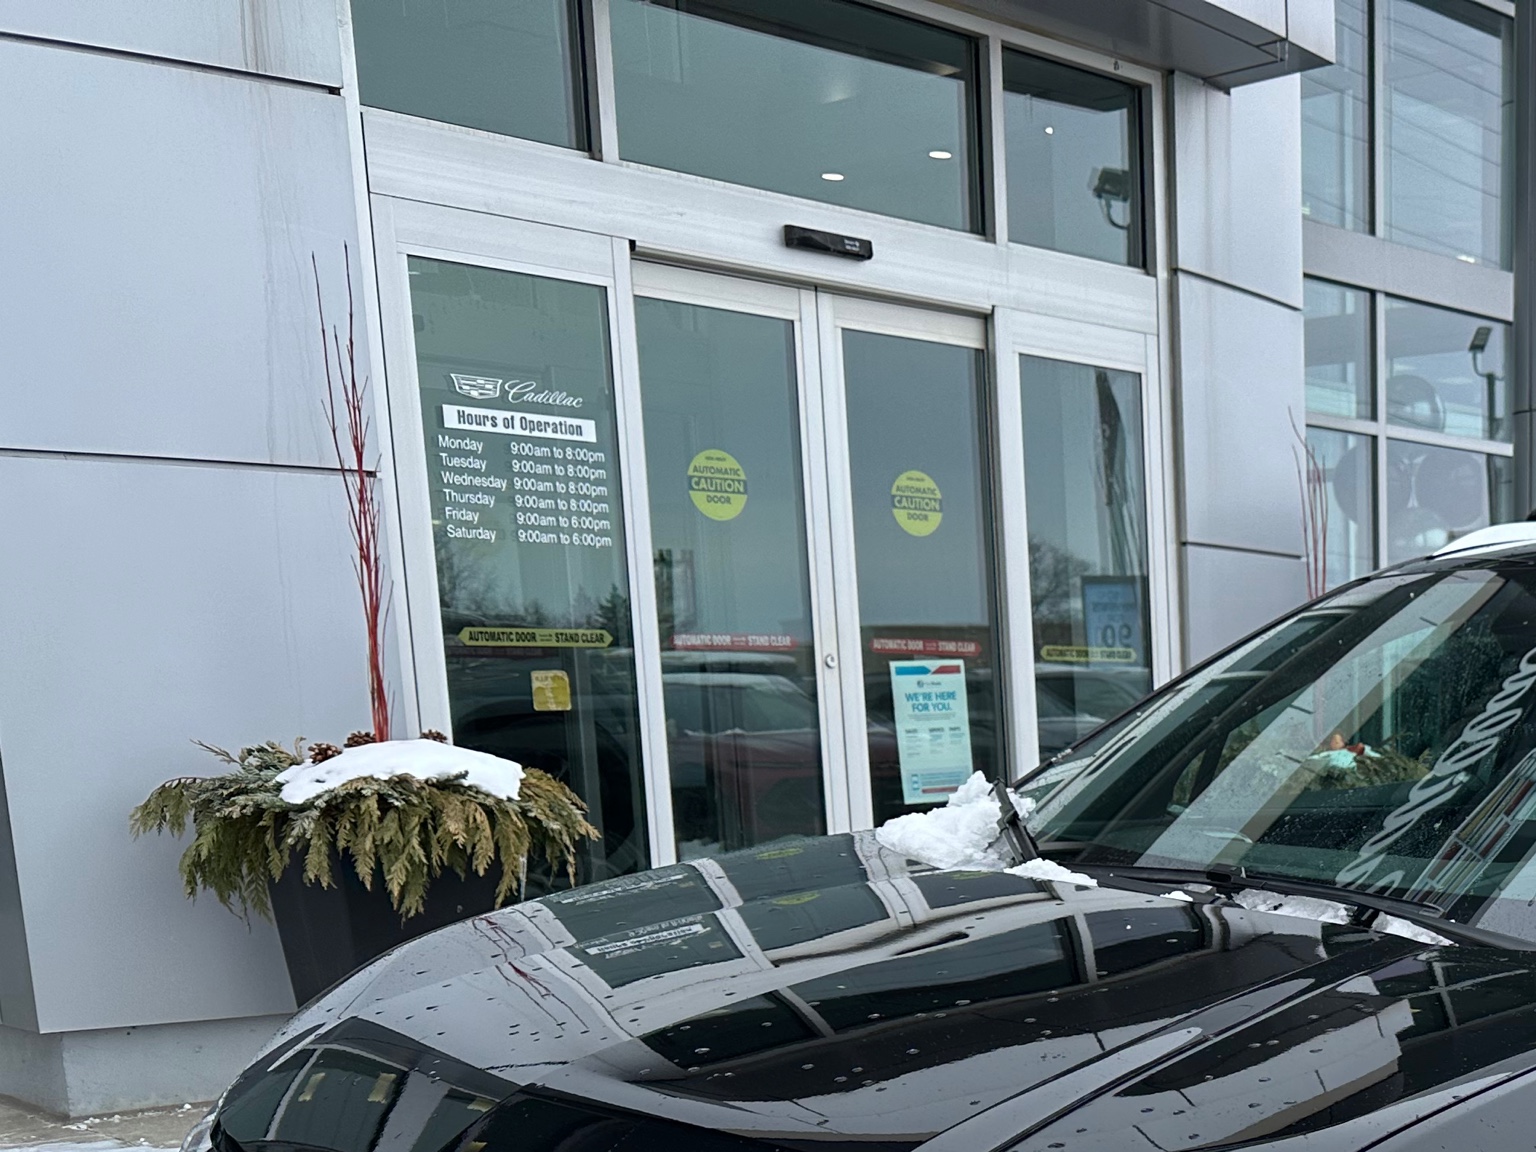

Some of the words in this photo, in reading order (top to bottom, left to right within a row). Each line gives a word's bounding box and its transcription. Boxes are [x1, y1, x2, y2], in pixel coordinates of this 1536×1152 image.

[504, 380, 583, 408] Cadillac
[457, 409, 498, 428] Hours
[503, 415, 516, 430] of
[520, 416, 583, 437] Operation
[438, 434, 483, 454] Monday
[510, 442, 551, 457] 9:00am
[553, 446, 564, 458] to
[565, 447, 605, 463] 8:00pm
[439, 452, 487, 472] Tuesday
[511, 460, 552, 475] 9:00am
[554, 464, 565, 476] to
[567, 465, 607, 480] 8:00pm
[693, 465, 741, 477] AUTOMATIC
[441, 471, 507, 491] Wednesday
[513, 477, 554, 493] 9:00am
[556, 481, 566, 494] to
[568, 482, 608, 498] 8:00pm
[691, 477, 745, 492] CAUTION
[896, 485, 937, 496] AUTOMATIC
[443, 488, 495, 508] Thursday
[515, 495, 555, 510] 9:00am
[557, 498, 568, 511] to
[570, 499, 609, 515] 8:00pm
[706, 494, 731, 505] DOOR
[894, 496, 940, 511] CAUTION
[445, 506, 479, 525] Friday
[516, 512, 557, 527] 9:00am
[558, 515, 569, 528] to
[571, 516, 611, 532] 6:00pm
[907, 512, 929, 521] DOOR
[446, 524, 497, 543] Saturday
[518, 530, 558, 545] 9:00am
[559, 532, 571, 546] to
[572, 533, 612, 549] 6:00pm
[469, 631, 513, 642] AUTOMATIC
[515, 632, 537, 643] DOOR
[554, 633, 579, 643] STAND
[581, 633, 605, 644] CLEAR
[905, 691, 933, 702] WE'RE
[935, 690, 957, 701] HERE
[912, 702, 930, 712] FOR
